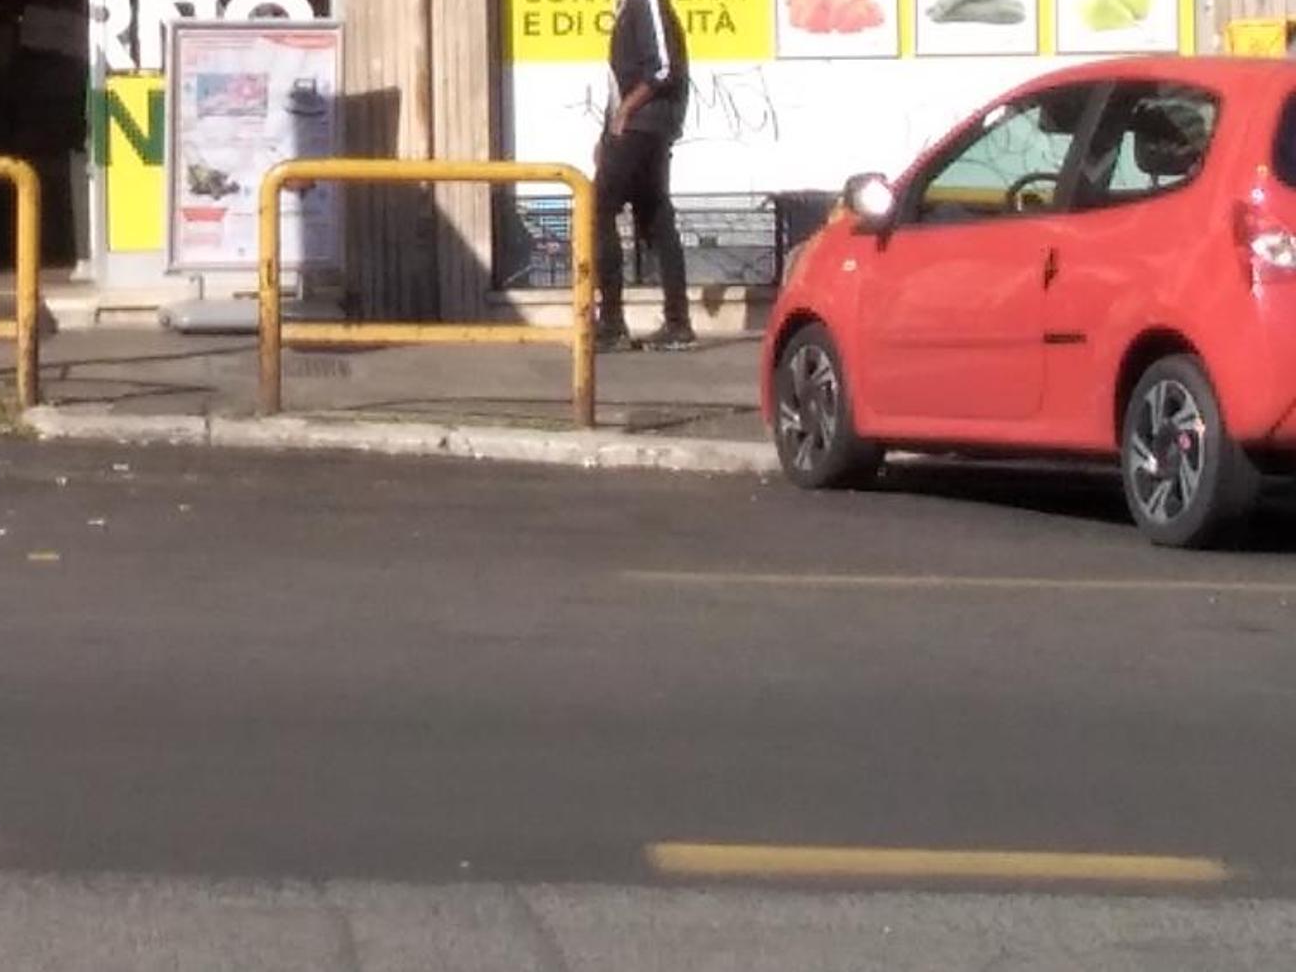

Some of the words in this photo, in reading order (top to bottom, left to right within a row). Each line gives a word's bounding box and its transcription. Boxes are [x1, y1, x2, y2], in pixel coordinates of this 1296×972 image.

[523, 11, 541, 36] E
[553, 11, 583, 36] DI
[594, 2, 736, 36] QITÀ
